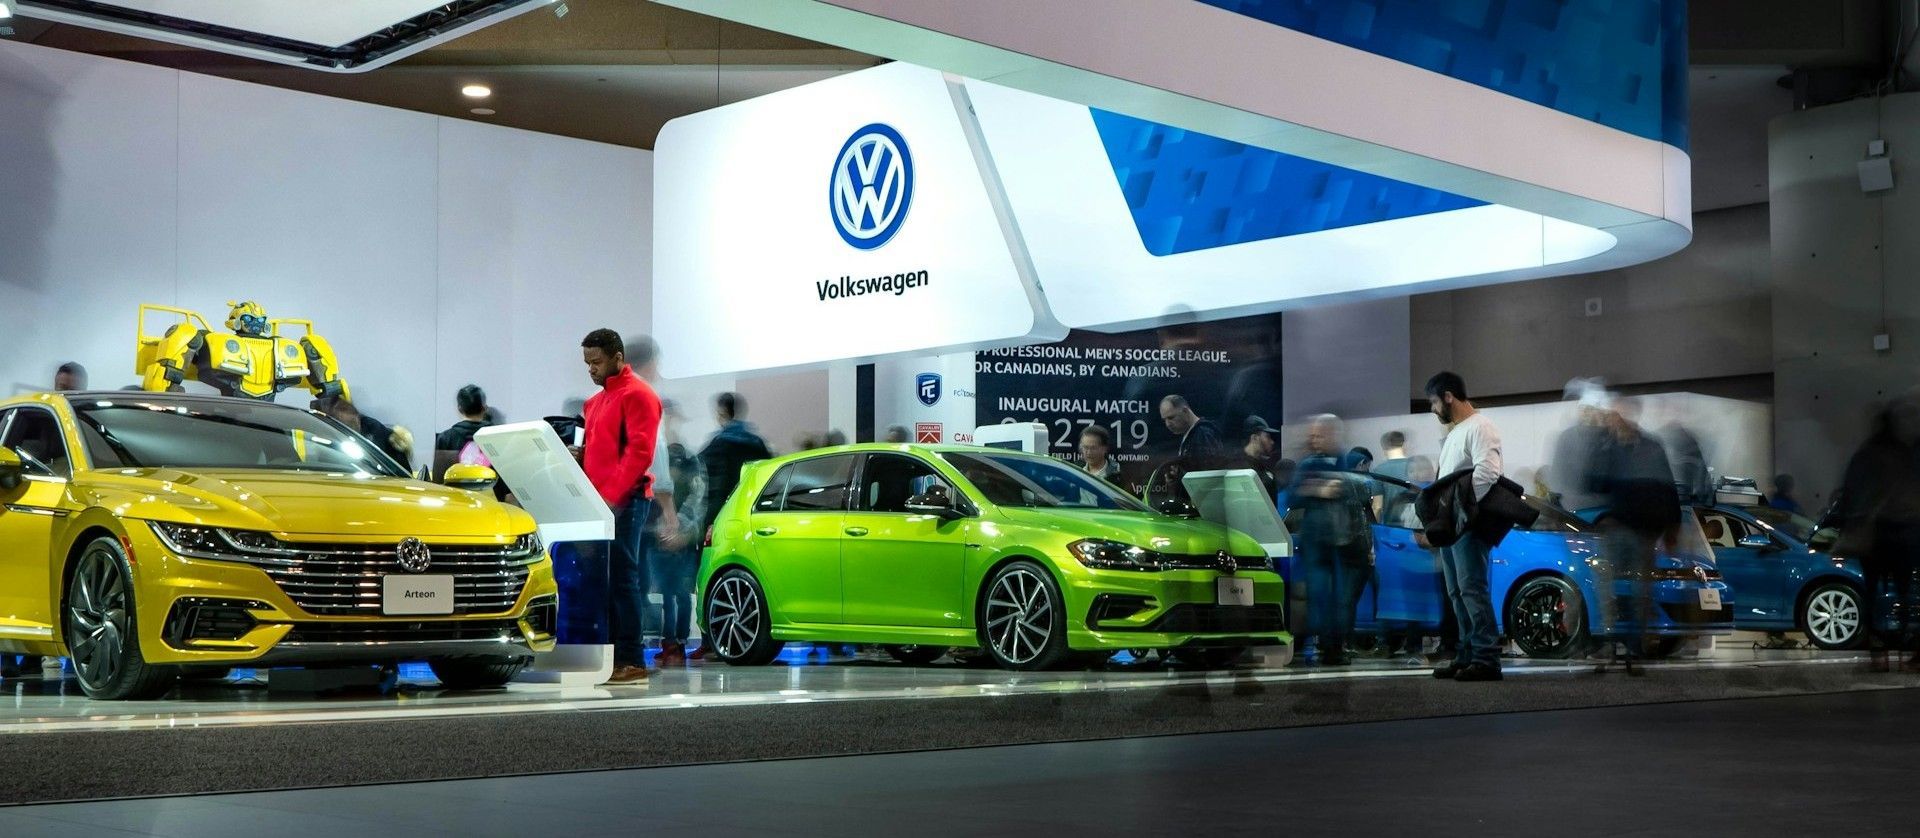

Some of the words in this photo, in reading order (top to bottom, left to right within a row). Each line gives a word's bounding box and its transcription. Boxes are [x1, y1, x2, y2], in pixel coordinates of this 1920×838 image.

[816, 269, 929, 301] Volkswagen
[1085, 348, 1122, 360] MEN'S
[1125, 349, 1175, 361] SOCCER
[1178, 350, 1231, 363] LEAGUE.
[995, 362, 1076, 377] CANADIANS,
[1079, 364, 1096, 376] BY
[1101, 365, 1181, 378] CANADIANS.
[998, 397, 1092, 412] INAUGURAL
[1095, 400, 1149, 413] MATCH
[1117, 454, 1150, 462] ONTARIO
[404, 589, 436, 599] Arteon
